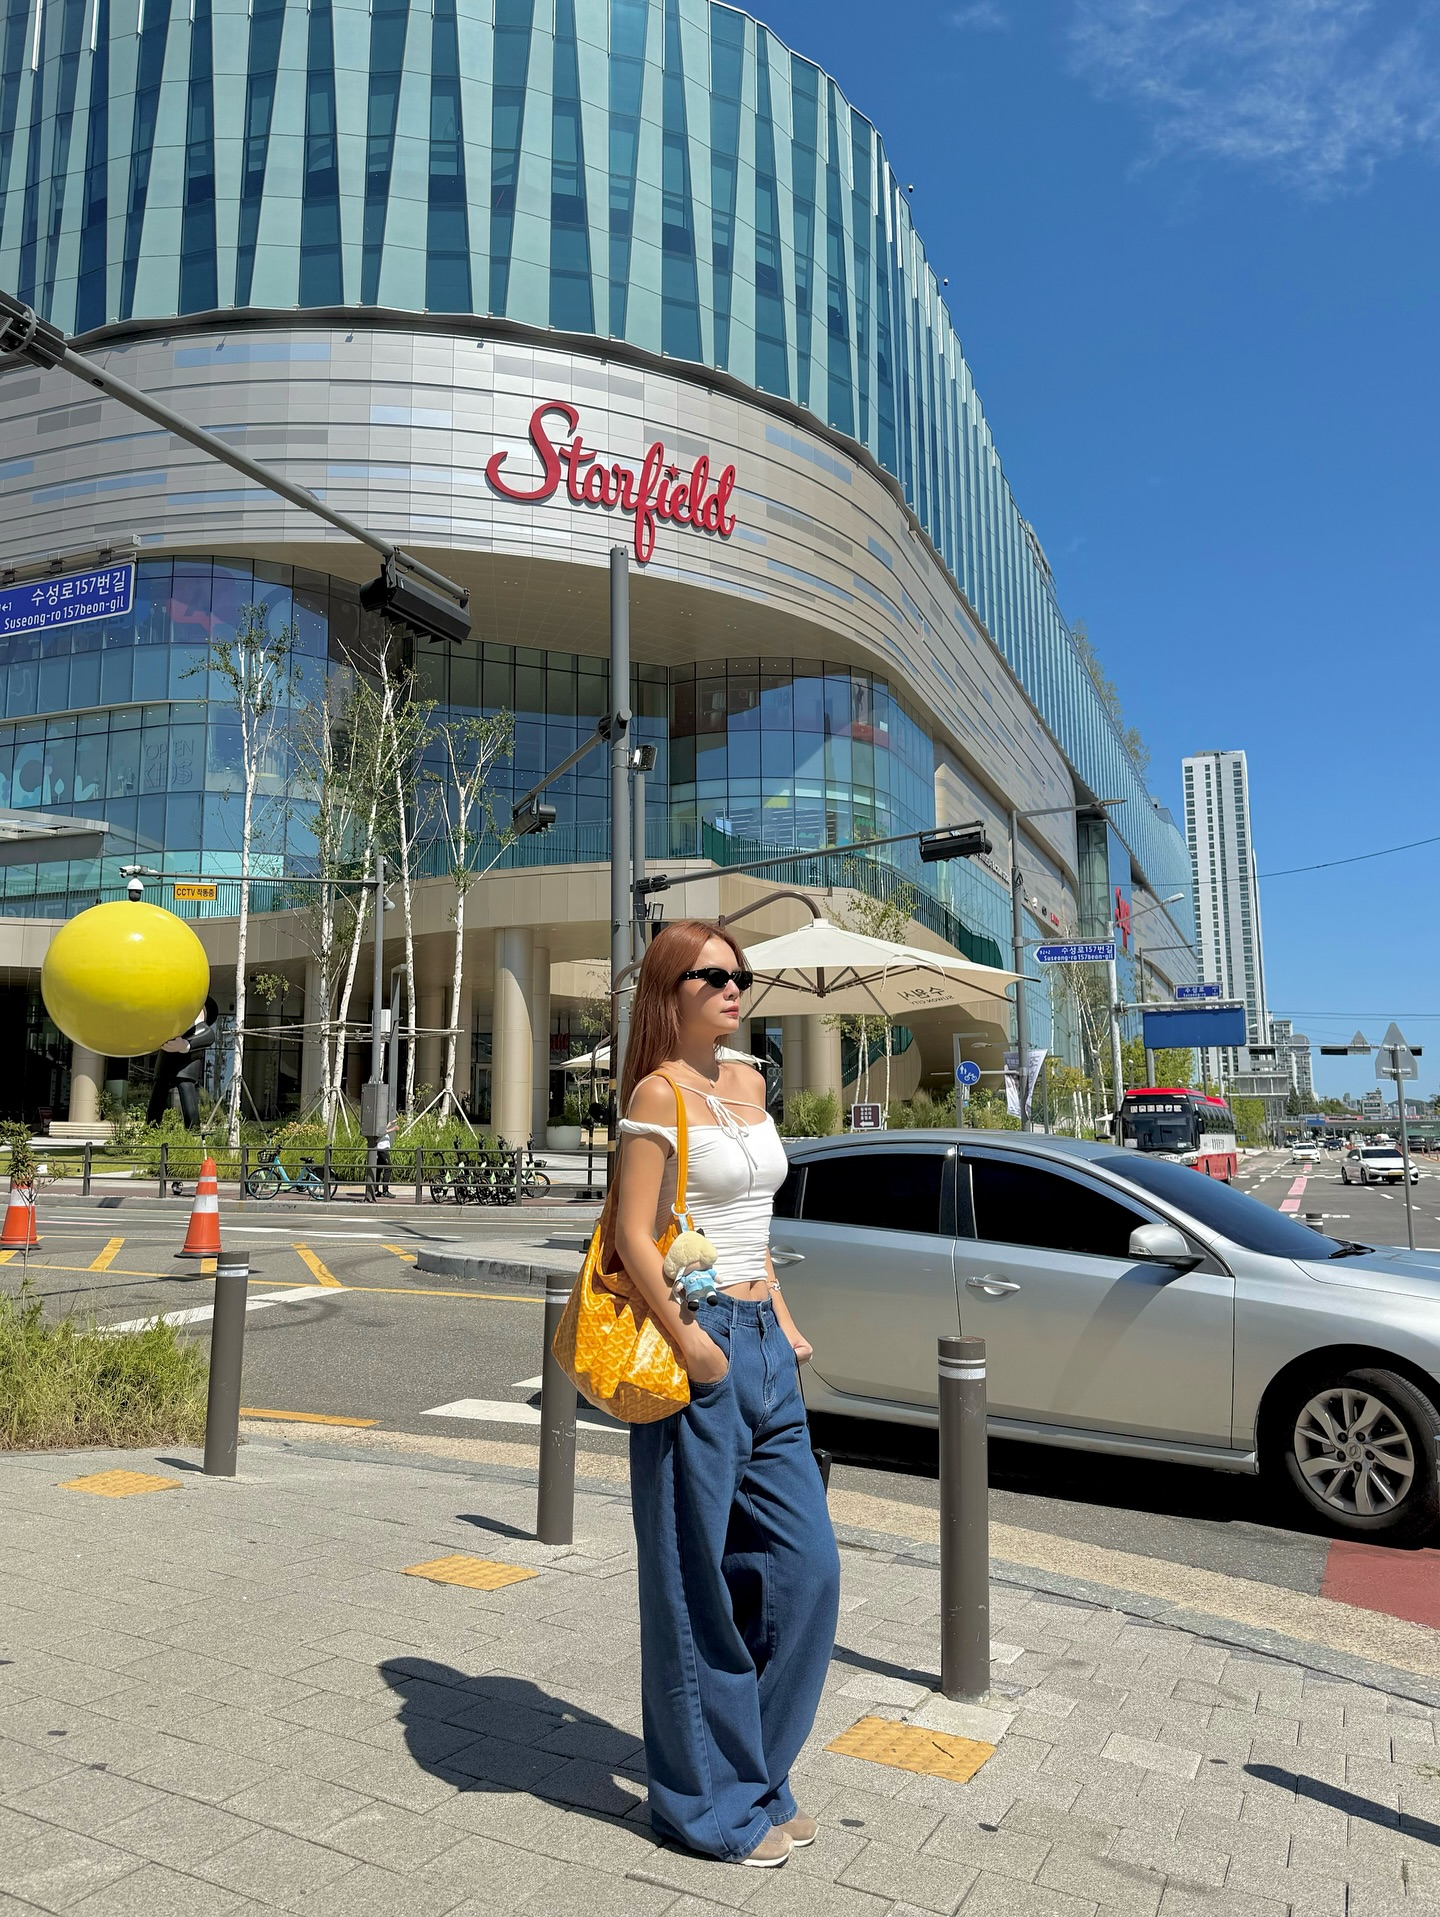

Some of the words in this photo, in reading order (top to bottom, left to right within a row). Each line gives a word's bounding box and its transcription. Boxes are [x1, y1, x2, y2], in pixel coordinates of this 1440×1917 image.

[485, 401, 736, 562] Starfield
[31, 570, 126, 606] 수성로157번길
[4, 609, 61, 630] Suseong-ro
[63, 595, 124, 619] 157beon-gil
[145, 740, 194, 760] OPEN
[144, 759, 193, 788] KIDS
[176, 888, 196, 896] CCTV
[196, 888, 215, 898] 작동중
[1061, 945, 1113, 955] 수성로157번길
[1078, 953, 1113, 961] 157beon-gil
